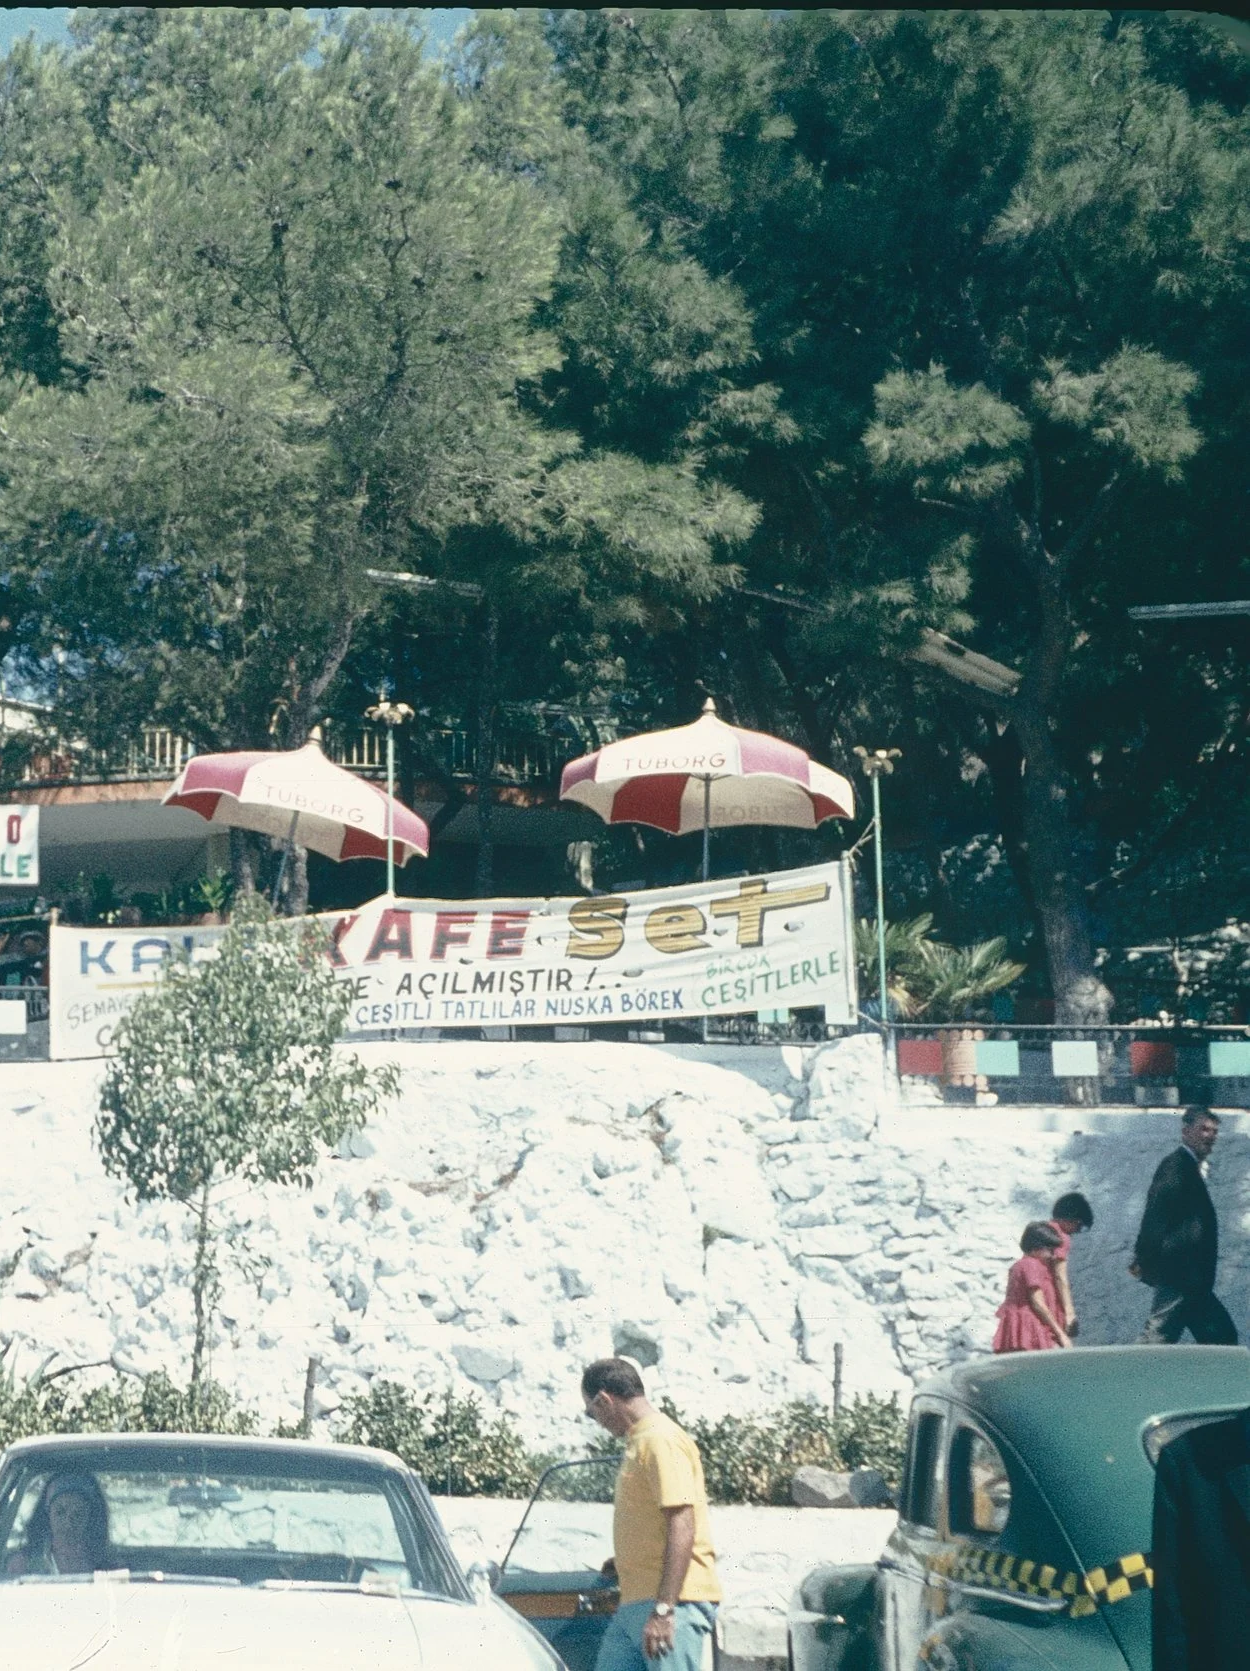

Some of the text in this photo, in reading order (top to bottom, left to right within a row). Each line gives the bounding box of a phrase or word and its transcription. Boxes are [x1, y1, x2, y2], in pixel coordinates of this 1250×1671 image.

[623, 751, 727, 772] TUBORG
[266, 784, 365, 824] TUBORG
[395, 967, 573, 998] AÇILMIŞTIR
[701, 950, 841, 1010] ÇEŞİTLERLE
[441, 998, 536, 1021] TATLILAR
[544, 995, 613, 1017] NUSKA
[621, 986, 684, 1013] BÖREK
